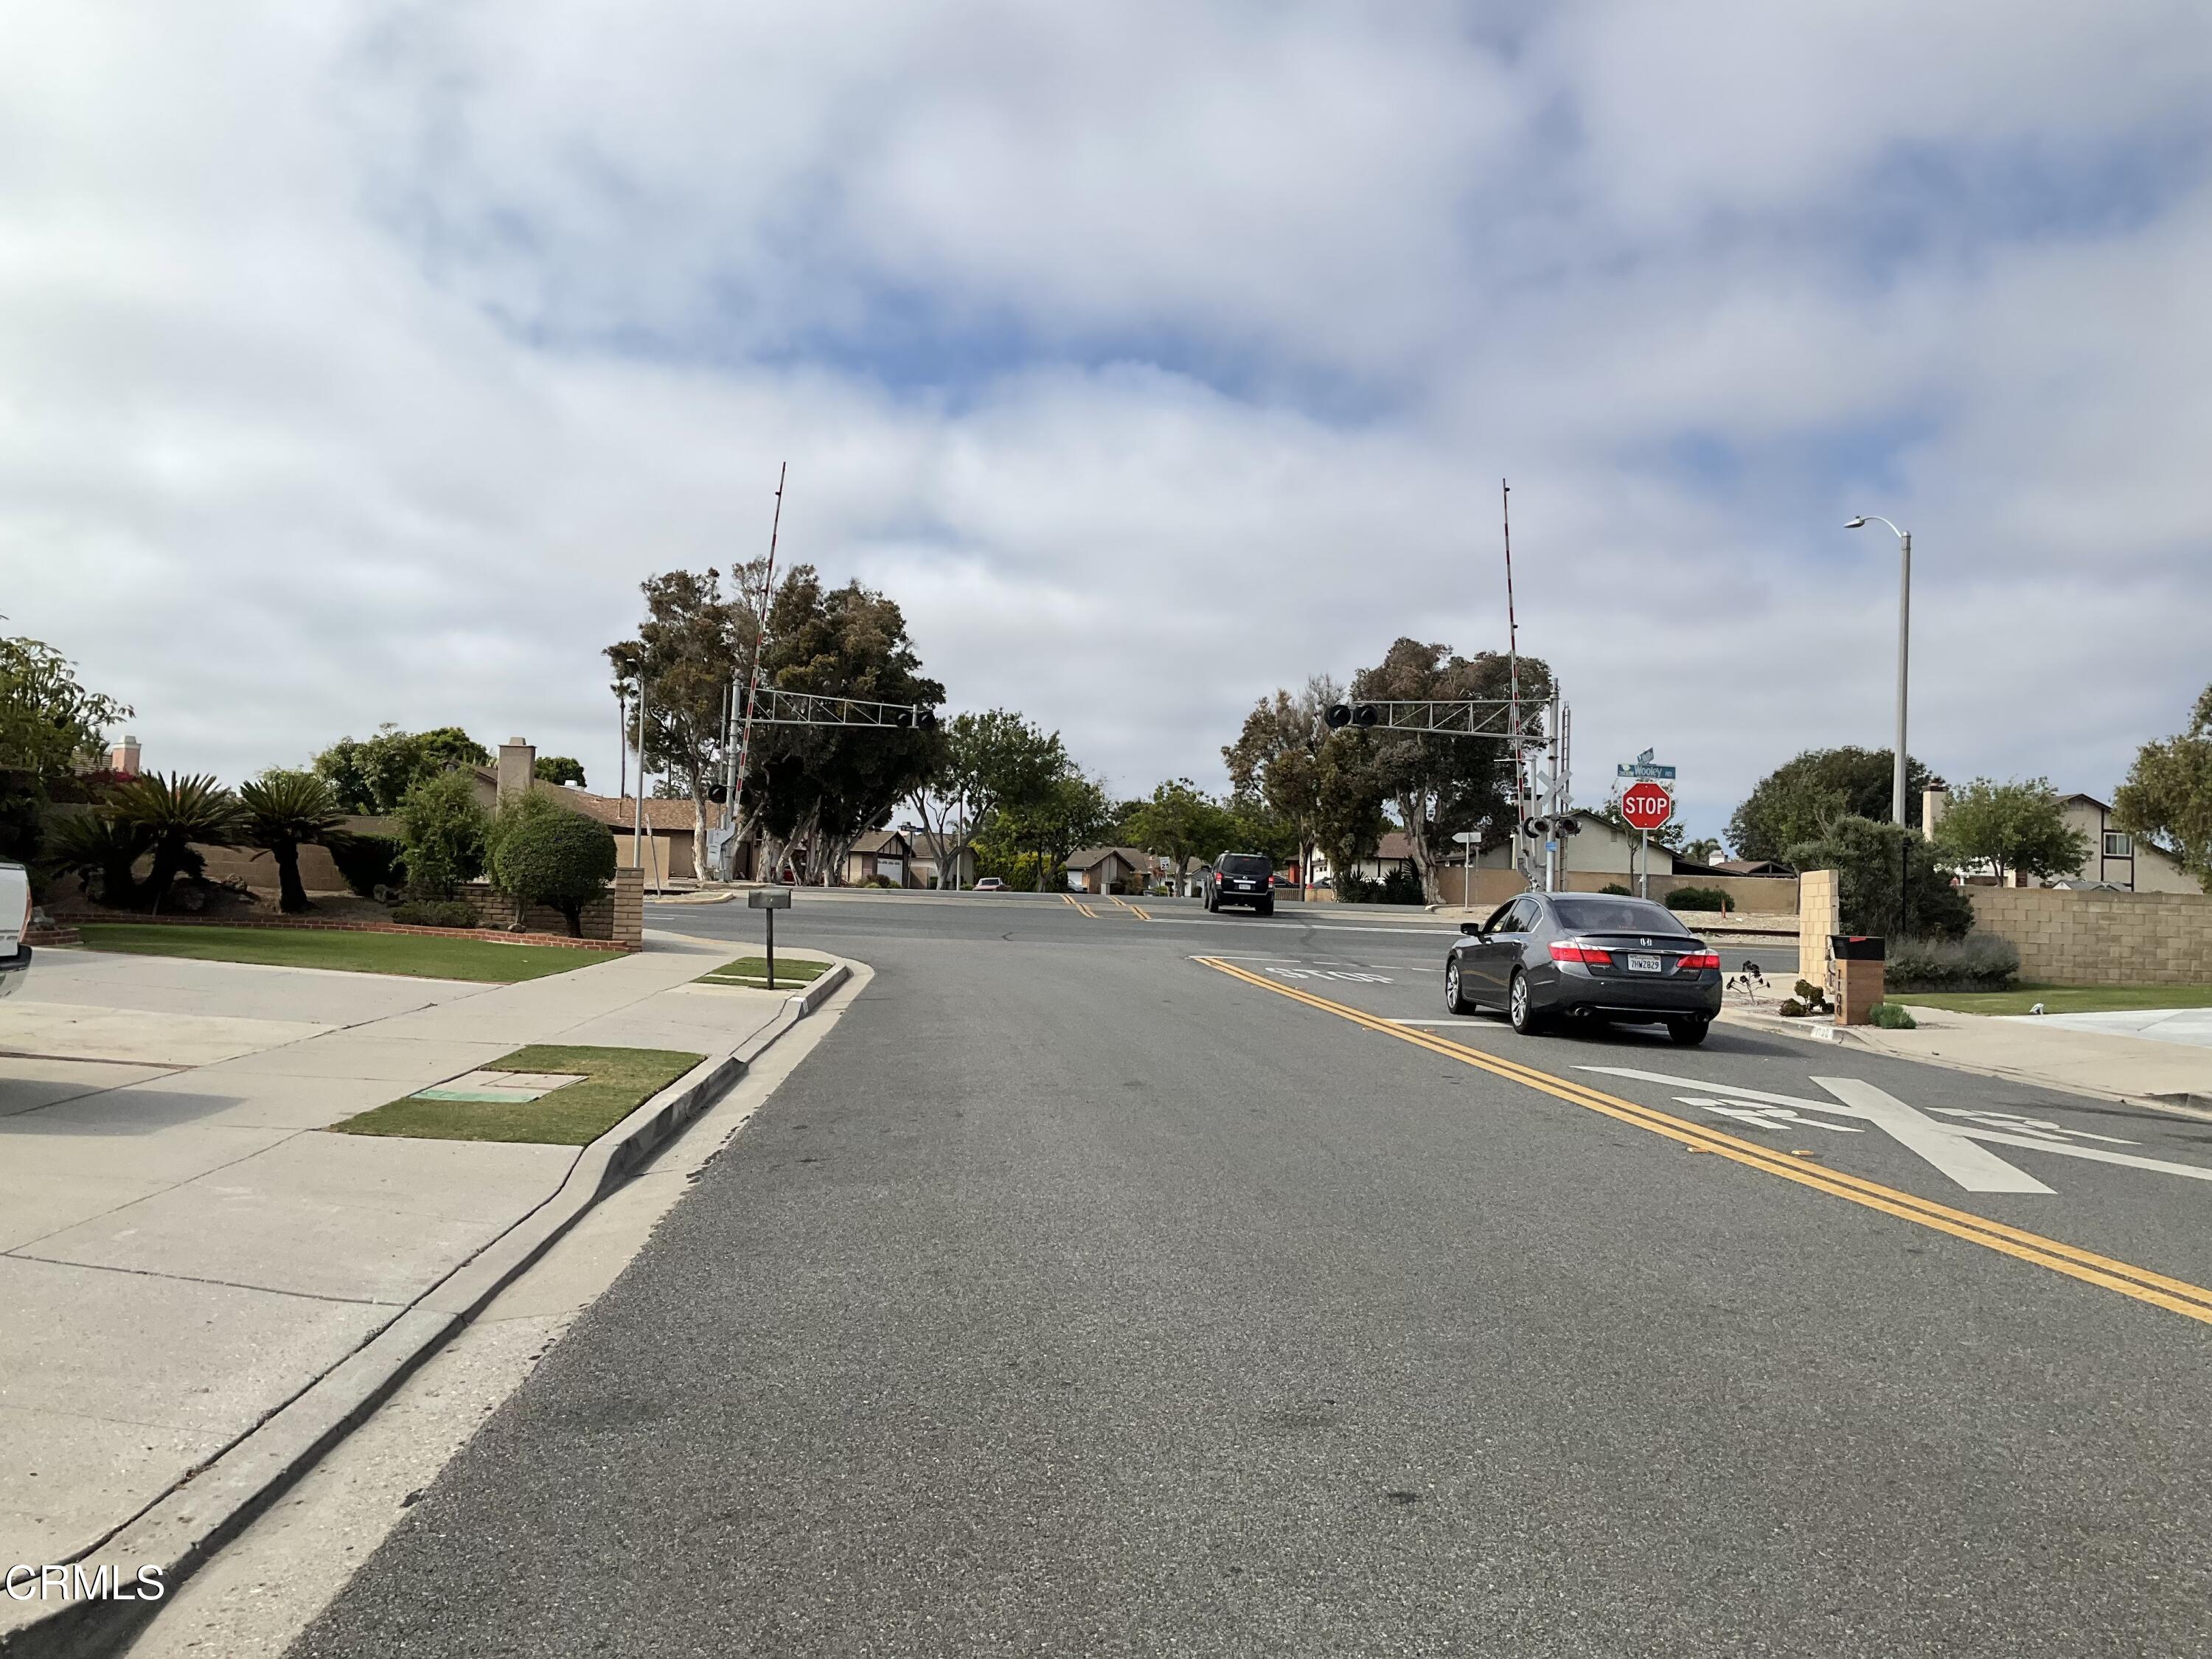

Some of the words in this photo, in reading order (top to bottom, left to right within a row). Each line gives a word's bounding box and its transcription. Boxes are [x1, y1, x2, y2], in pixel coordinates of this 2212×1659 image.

[1634, 765, 1663, 778] Wooley
[1625, 796, 1668, 815] STOP
[1630, 960, 1659, 970] 7HWZ829
[1265, 967, 1395, 984] STOP
